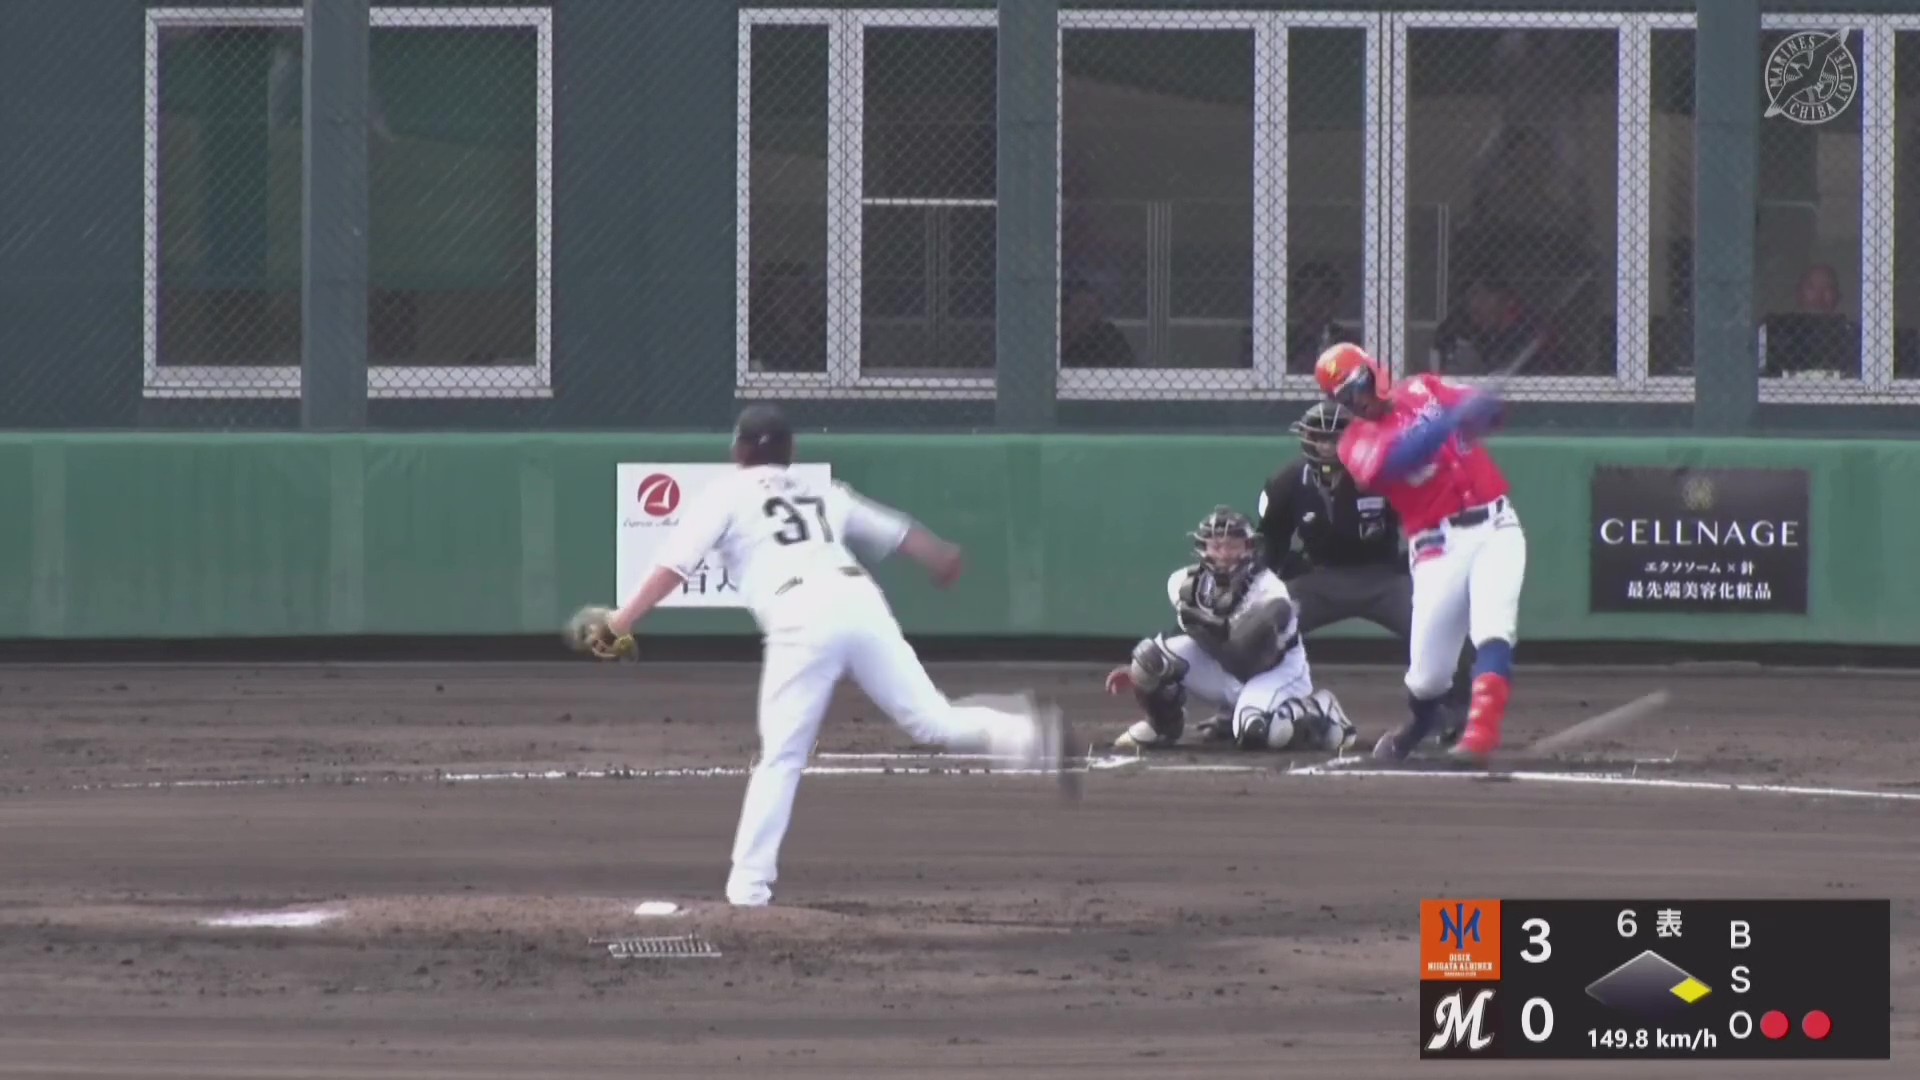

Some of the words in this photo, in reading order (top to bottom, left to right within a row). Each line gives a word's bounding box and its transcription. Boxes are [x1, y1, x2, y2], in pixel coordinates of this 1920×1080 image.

[762, 496, 834, 546] 37
[1600, 518, 1799, 546] CELLNAGE
[1627, 581, 1772, 600] 最先端美容化粧品
